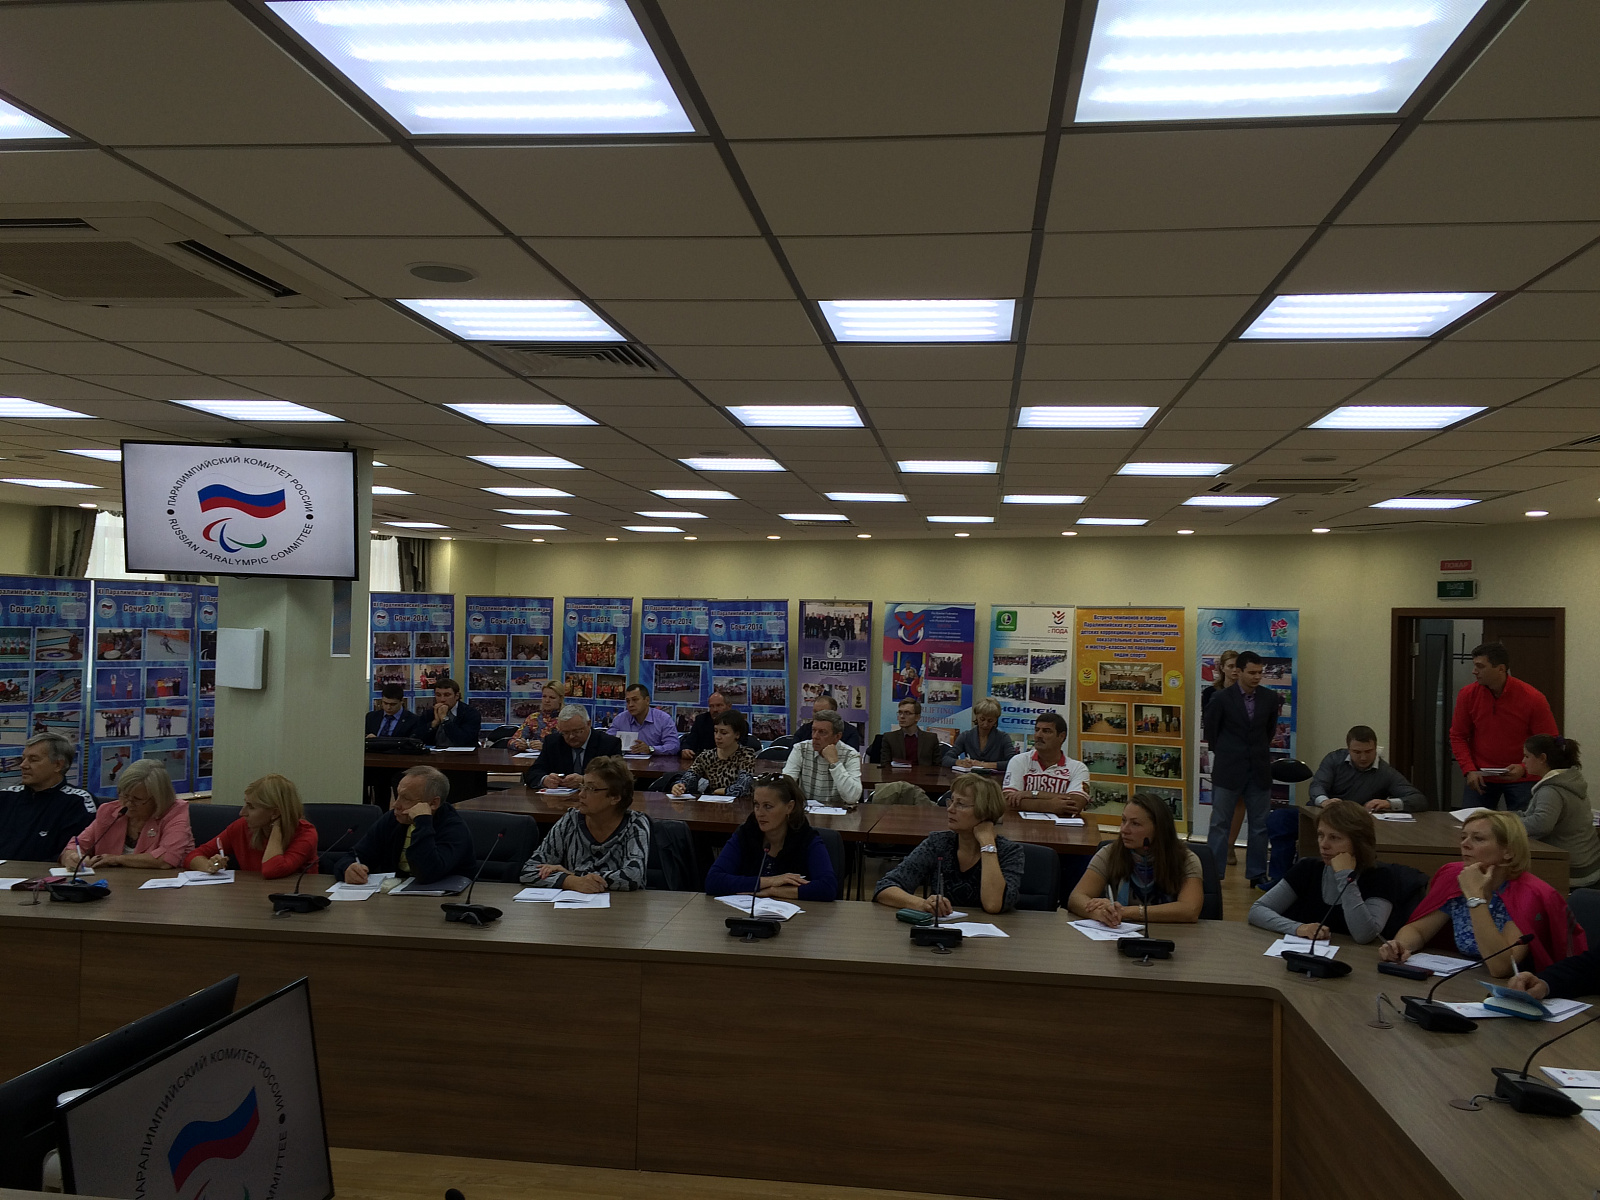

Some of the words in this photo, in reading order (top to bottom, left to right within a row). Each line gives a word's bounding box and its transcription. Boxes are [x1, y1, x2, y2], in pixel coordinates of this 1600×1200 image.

[167, 455, 241, 507] ПАРАЛИМПИЙСКИЙ
[243, 457, 291, 480] КОМИТЕТ
[289, 478, 313, 512] РОССИИ
[168, 518, 200, 552] RUSSIAN
[199, 548, 269, 567] PARALYMPIC
[270, 523, 314, 562] COMMITTEE
[9, 604, 57, 614] Сочи-2014
[123, 603, 164, 613] Сочи-2014
[394, 614, 429, 622] Сочи-2014
[490, 617, 526, 625] Сочи-2014
[730, 622, 764, 631] Сочи-2014
[1025, 774, 1069, 794] RUSSIA
[135, 1055, 208, 1200] АРАЛИМПИЙСКИЙ
[209, 1047, 260, 1068] КОМИТЕТ
[258, 1061, 285, 1111] РОССИИ
